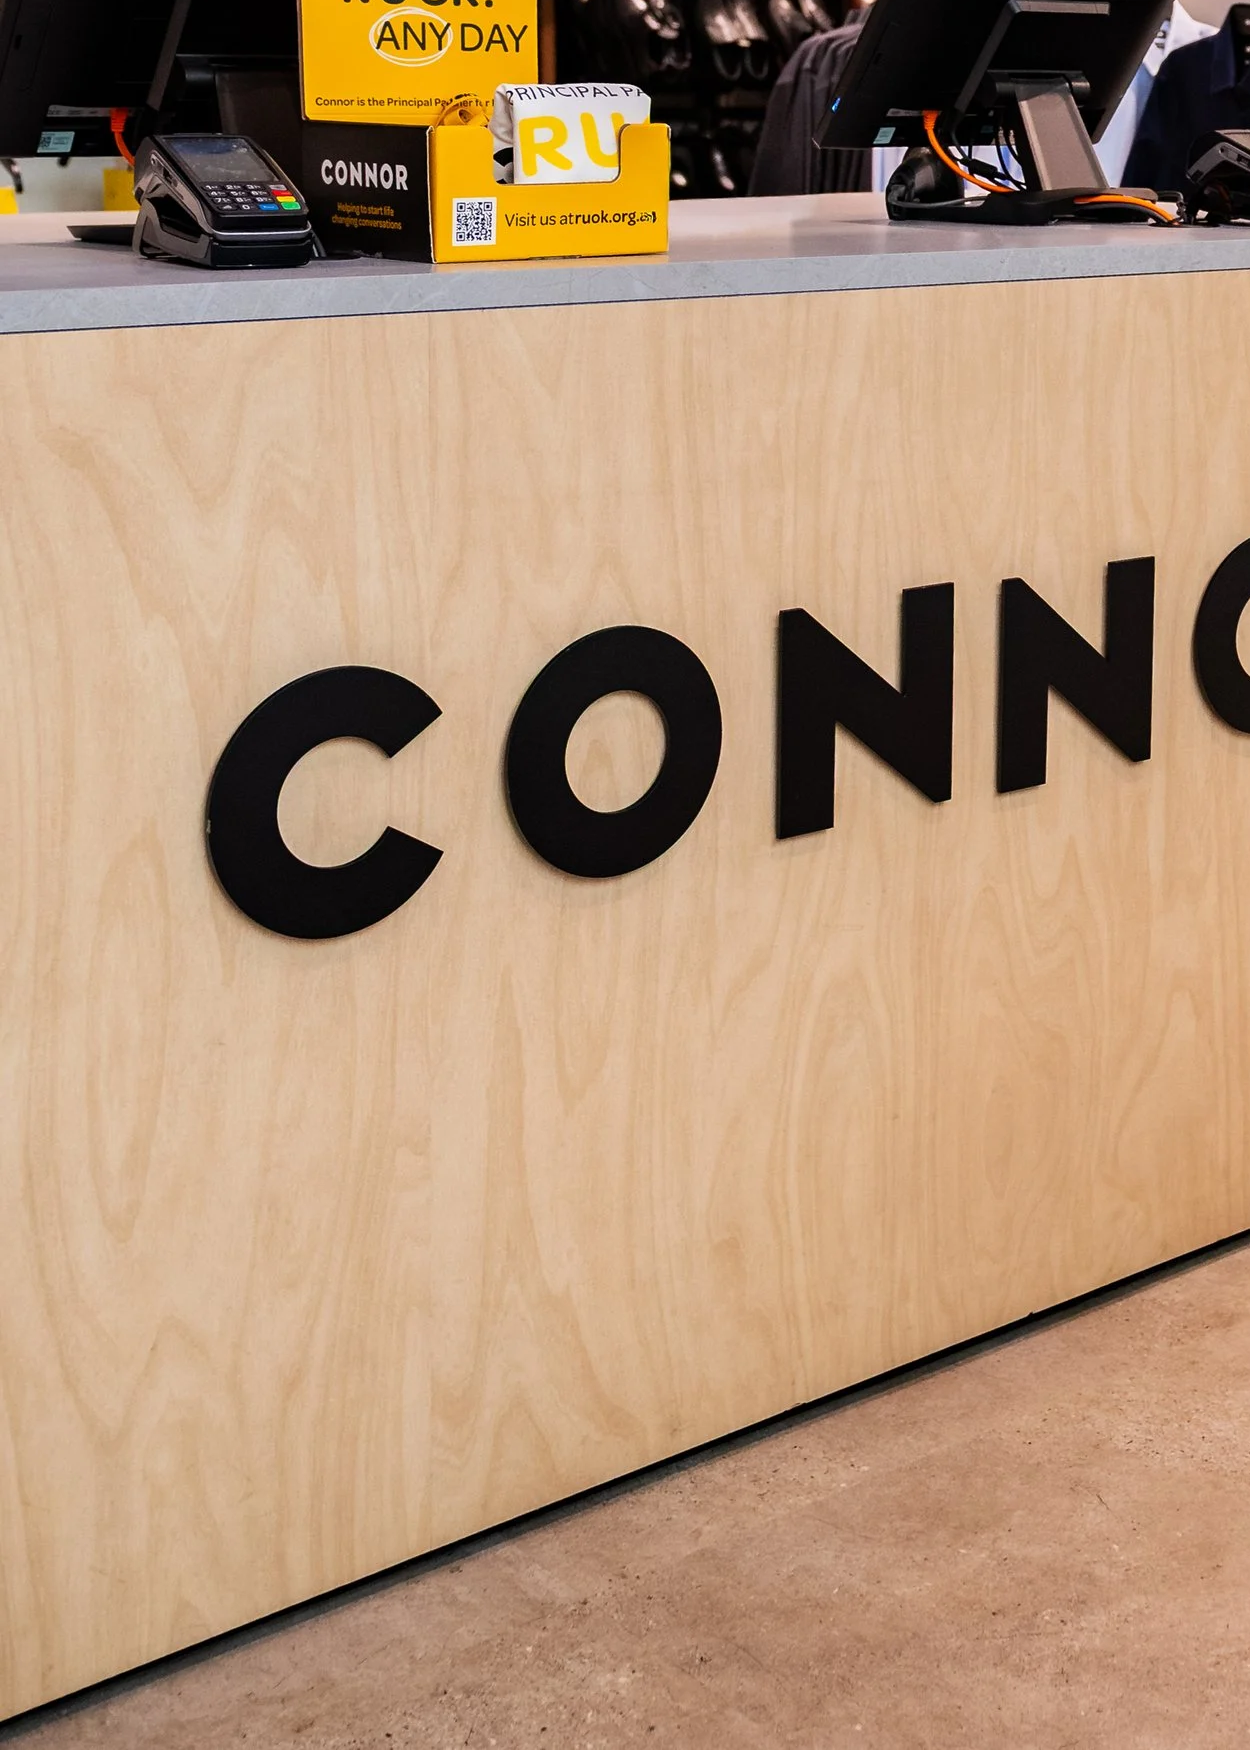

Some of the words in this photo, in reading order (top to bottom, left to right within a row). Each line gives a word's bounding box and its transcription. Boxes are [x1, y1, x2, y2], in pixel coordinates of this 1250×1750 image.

[375, 20, 451, 51] ANY
[460, 23, 528, 53] DAY
[315, 96, 354, 107] Connor
[356, 96, 365, 107] is
[367, 96, 384, 107] the
[387, 96, 432, 109] Principal
[321, 158, 409, 191] CONNOR
[505, 213, 536, 227] Visit
[544, 215, 557, 226] us
